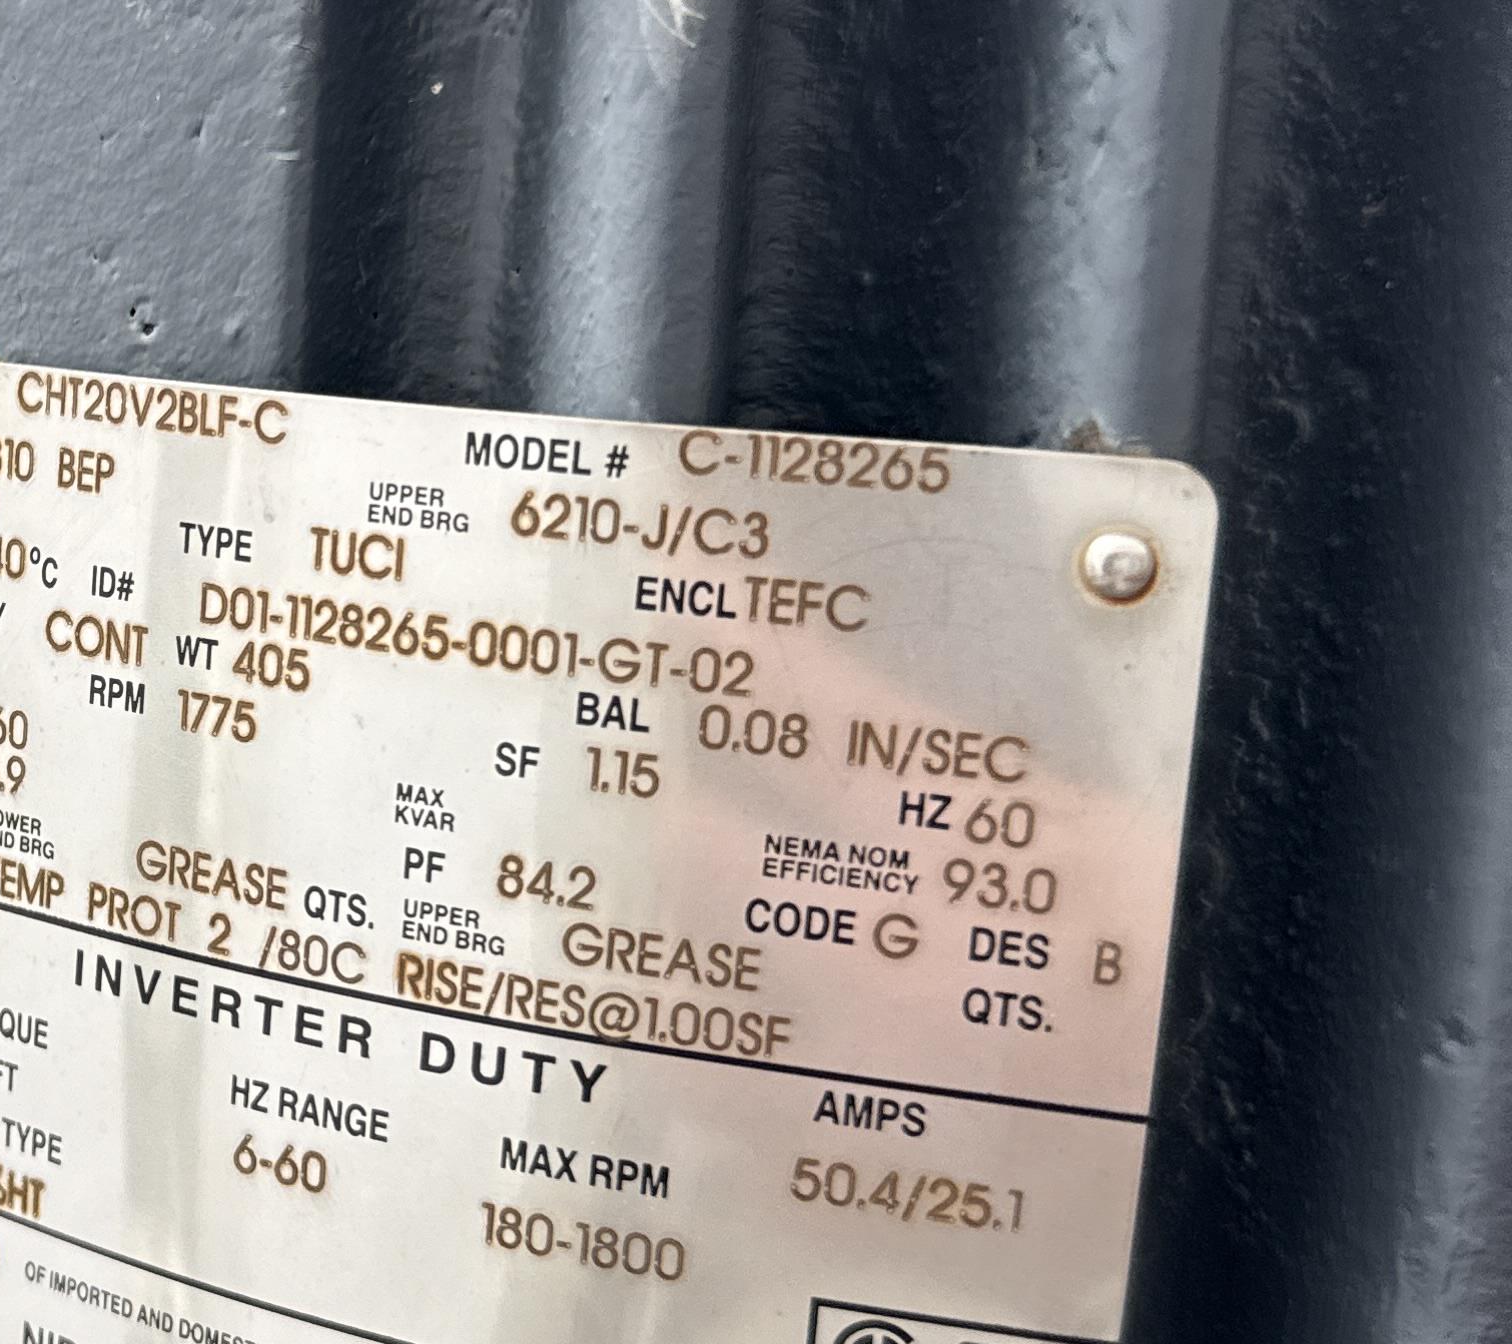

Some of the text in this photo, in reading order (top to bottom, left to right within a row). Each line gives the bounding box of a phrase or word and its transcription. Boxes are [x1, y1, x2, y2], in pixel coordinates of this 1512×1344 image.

[16, 370, 290, 446] CHT20V2BLF-C
[57, 448, 116, 494] BEP
[464, 431, 630, 478] MODEL #
[678, 429, 952, 495] C-1128265
[369, 481, 445, 507] UPPER
[367, 505, 470, 533] END BRG
[510, 489, 770, 559] 6210-J/C3
[180, 523, 253, 563] TYPE
[310, 526, 405, 581] TUCI
[91, 565, 135, 601] ID#
[635, 576, 737, 619] ENCL
[745, 576, 871, 632] TEFC
[45, 610, 149, 667] CONT
[176, 635, 219, 671] WT
[232, 641, 311, 692] 405
[89, 674, 146, 715] RPM
[177, 689, 257, 743] 1775
[576, 692, 650, 733] BAL
[494, 742, 540, 778] SF
[698, 703, 1030, 784] 0.08 IN/SEC
[396, 783, 445, 808] MAX
[587, 746, 661, 800] 1.15
[394, 805, 456, 832] KVAR
[898, 791, 952, 831] HZ
[964, 798, 1036, 850] 60
[20, 836, 56, 860] BRG
[403, 846, 446, 883] PF
[764, 834, 911, 870] NEMA NOM
[136, 840, 288, 910] GREASE
[496, 854, 597, 911] 84.2
[761, 857, 918, 895] EFFICIENCY
[943, 857, 1058, 916] 93.0
[303, 886, 375, 929] QTS.
[403, 898, 480, 929] UPPER
[745, 898, 857, 945] CODE
[402, 921, 505, 956] END BRG
[562, 922, 762, 992] GREASE
[872, 913, 919, 959] G
[969, 926, 1050, 970] DES
[88, 882, 182, 942] PROT
[207, 913, 232, 956] 2
[259, 925, 367, 986] /80C
[396, 952, 792, 1058] RISE/RES@1.00SF
[1093, 939, 1123, 986] B
[74, 948, 608, 1104] INVERTER DUTY
[961, 988, 1053, 1033] QTS.
[230, 1074, 390, 1143] HZ RANGE
[813, 1090, 928, 1138] AMPS
[3, 1116, 63, 1166] TYPE
[233, 1134, 328, 1194] 6-60
[500, 1136, 670, 1198] MAX RPM
[790, 1156, 1025, 1232] 50.4/25.1
[481, 1201, 686, 1282] 180-1800
[24, 1260, 46, 1284] OF
[49, 1268, 134, 1319] IMPORTED
[136, 1303, 174, 1334] AND
